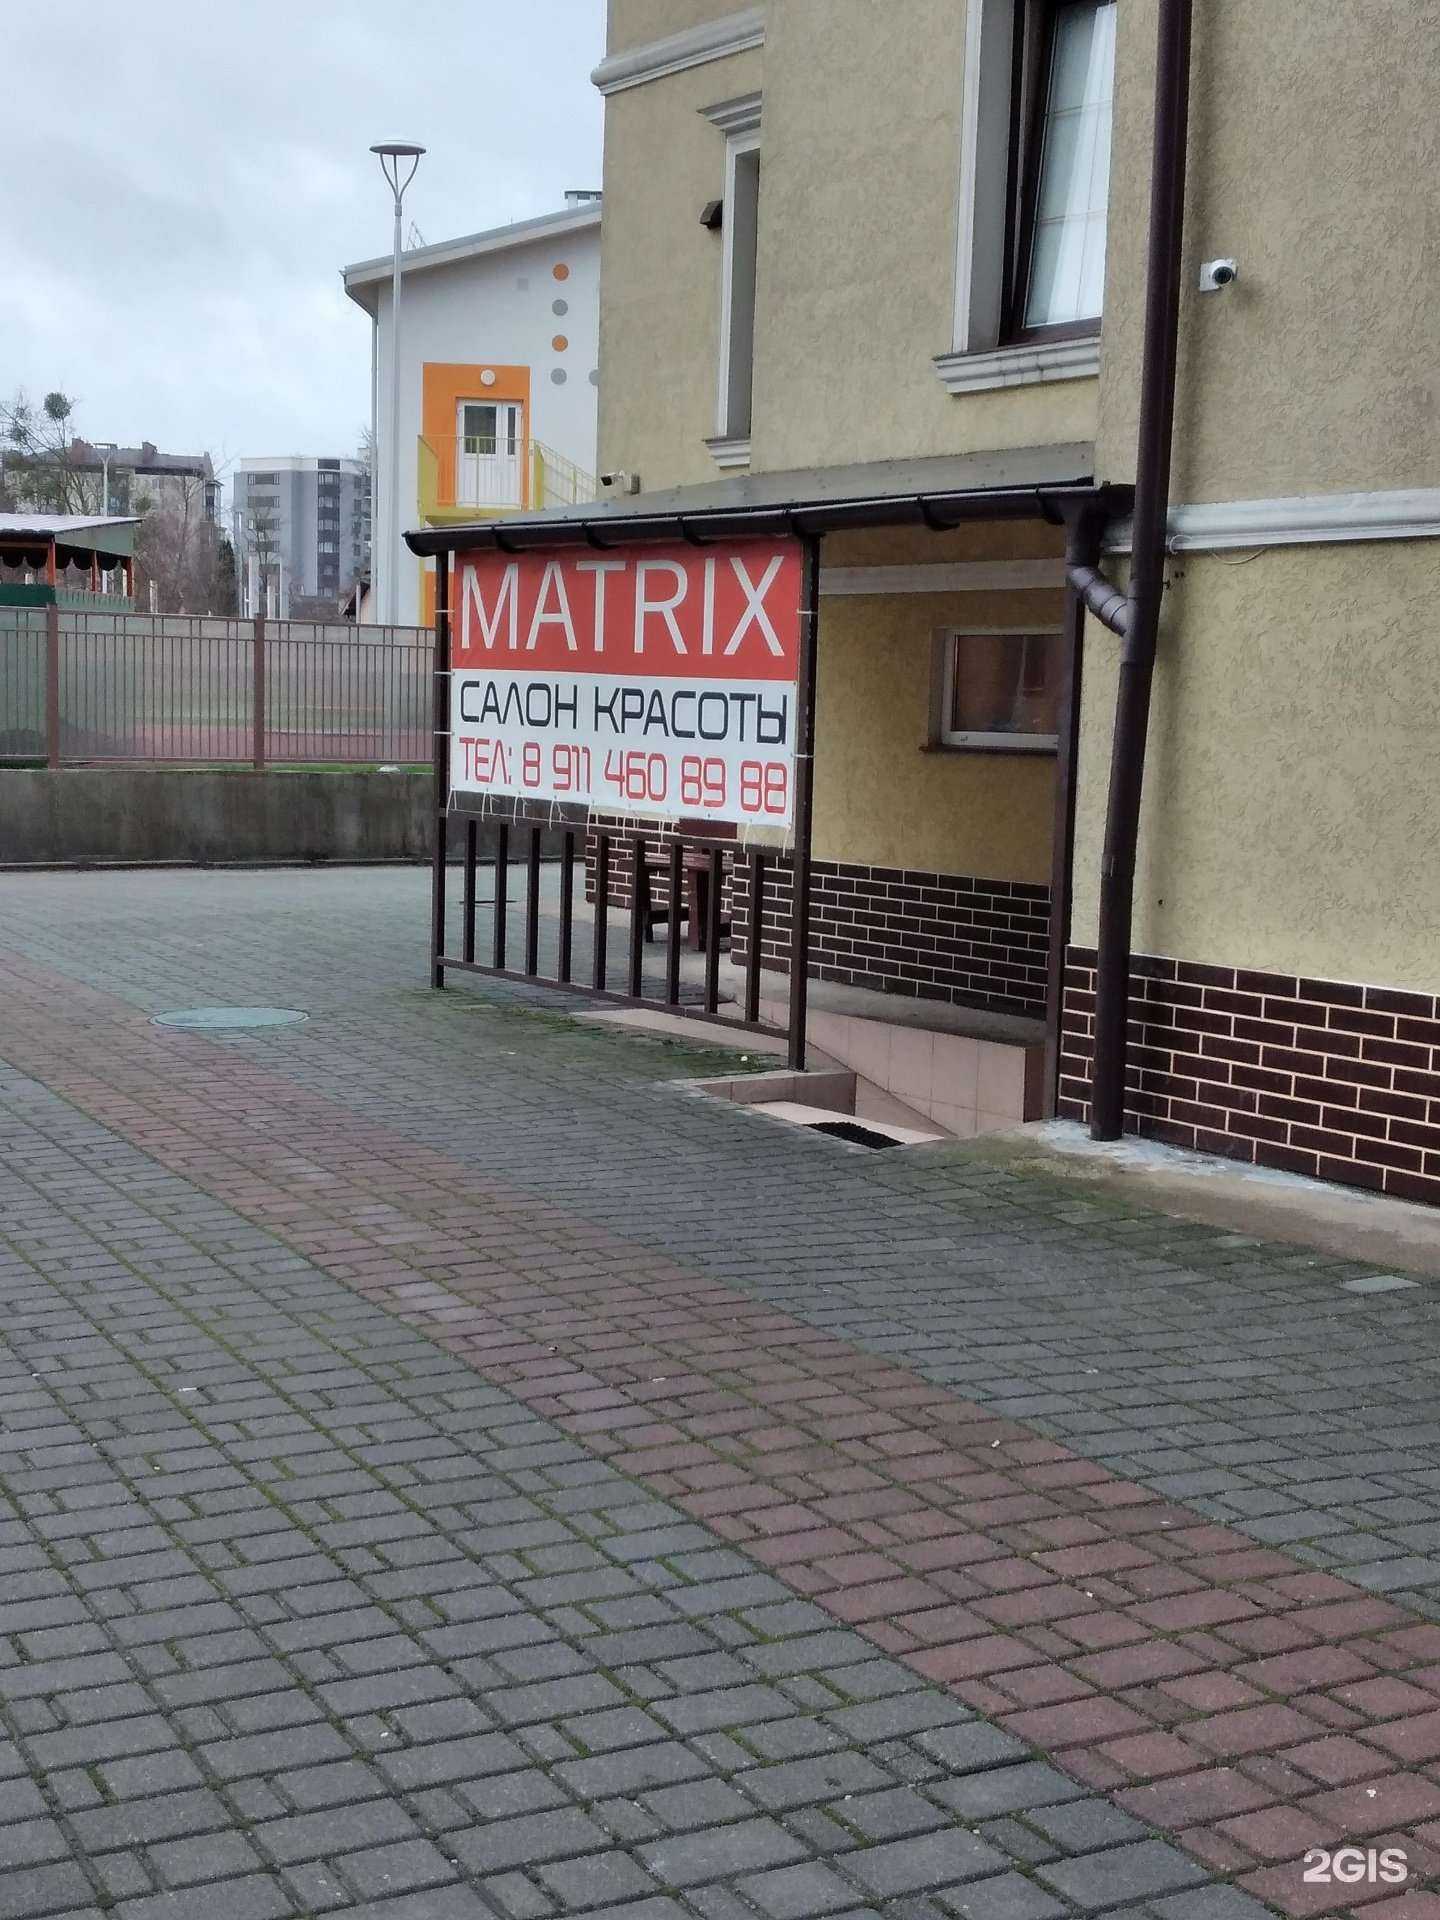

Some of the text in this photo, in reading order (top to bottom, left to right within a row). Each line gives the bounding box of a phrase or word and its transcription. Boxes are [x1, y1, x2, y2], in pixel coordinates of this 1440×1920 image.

[461, 556, 785, 656] MATRIX
[460, 680, 787, 744] САЛОН КРАСОТЫ
[459, 737, 787, 814] ТЕЛ: 8 911 460 89 88
